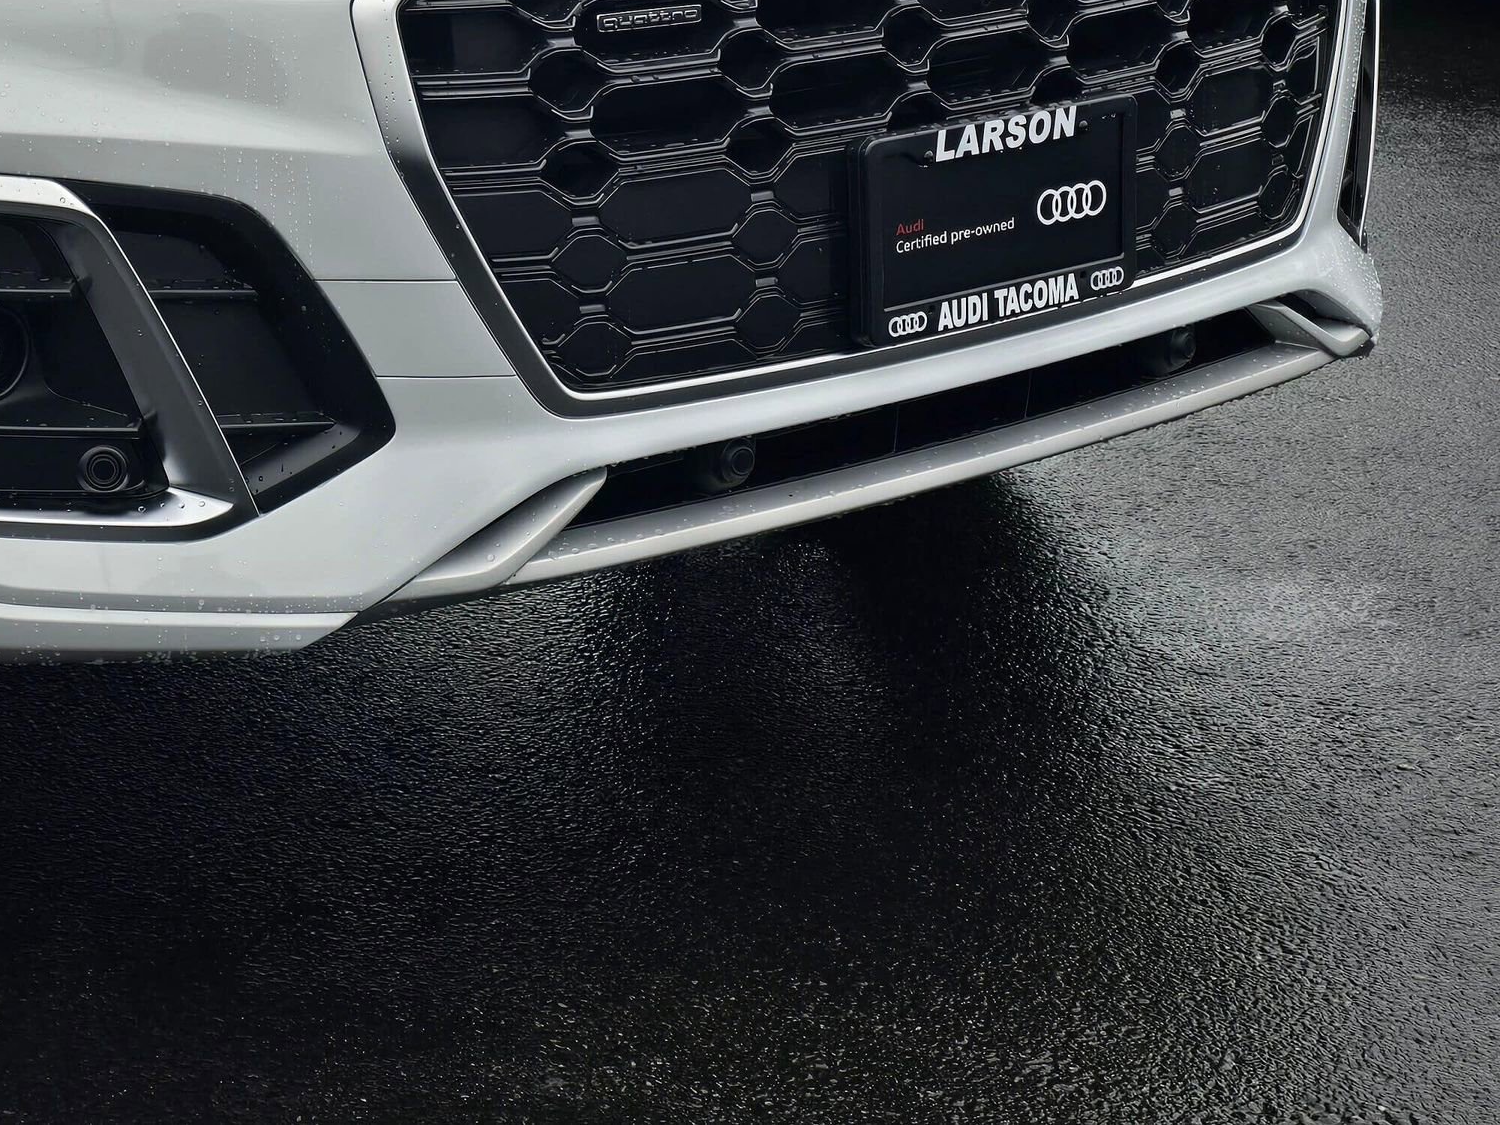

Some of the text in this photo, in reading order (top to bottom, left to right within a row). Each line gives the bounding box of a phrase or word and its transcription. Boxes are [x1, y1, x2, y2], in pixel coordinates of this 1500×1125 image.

[603, 9, 697, 28] quattro
[936, 106, 1076, 162] LARSON
[896, 219, 924, 236] Audi
[896, 217, 1015, 253] Certified pre-owned
[938, 273, 1079, 331] AUDI TACOMA
